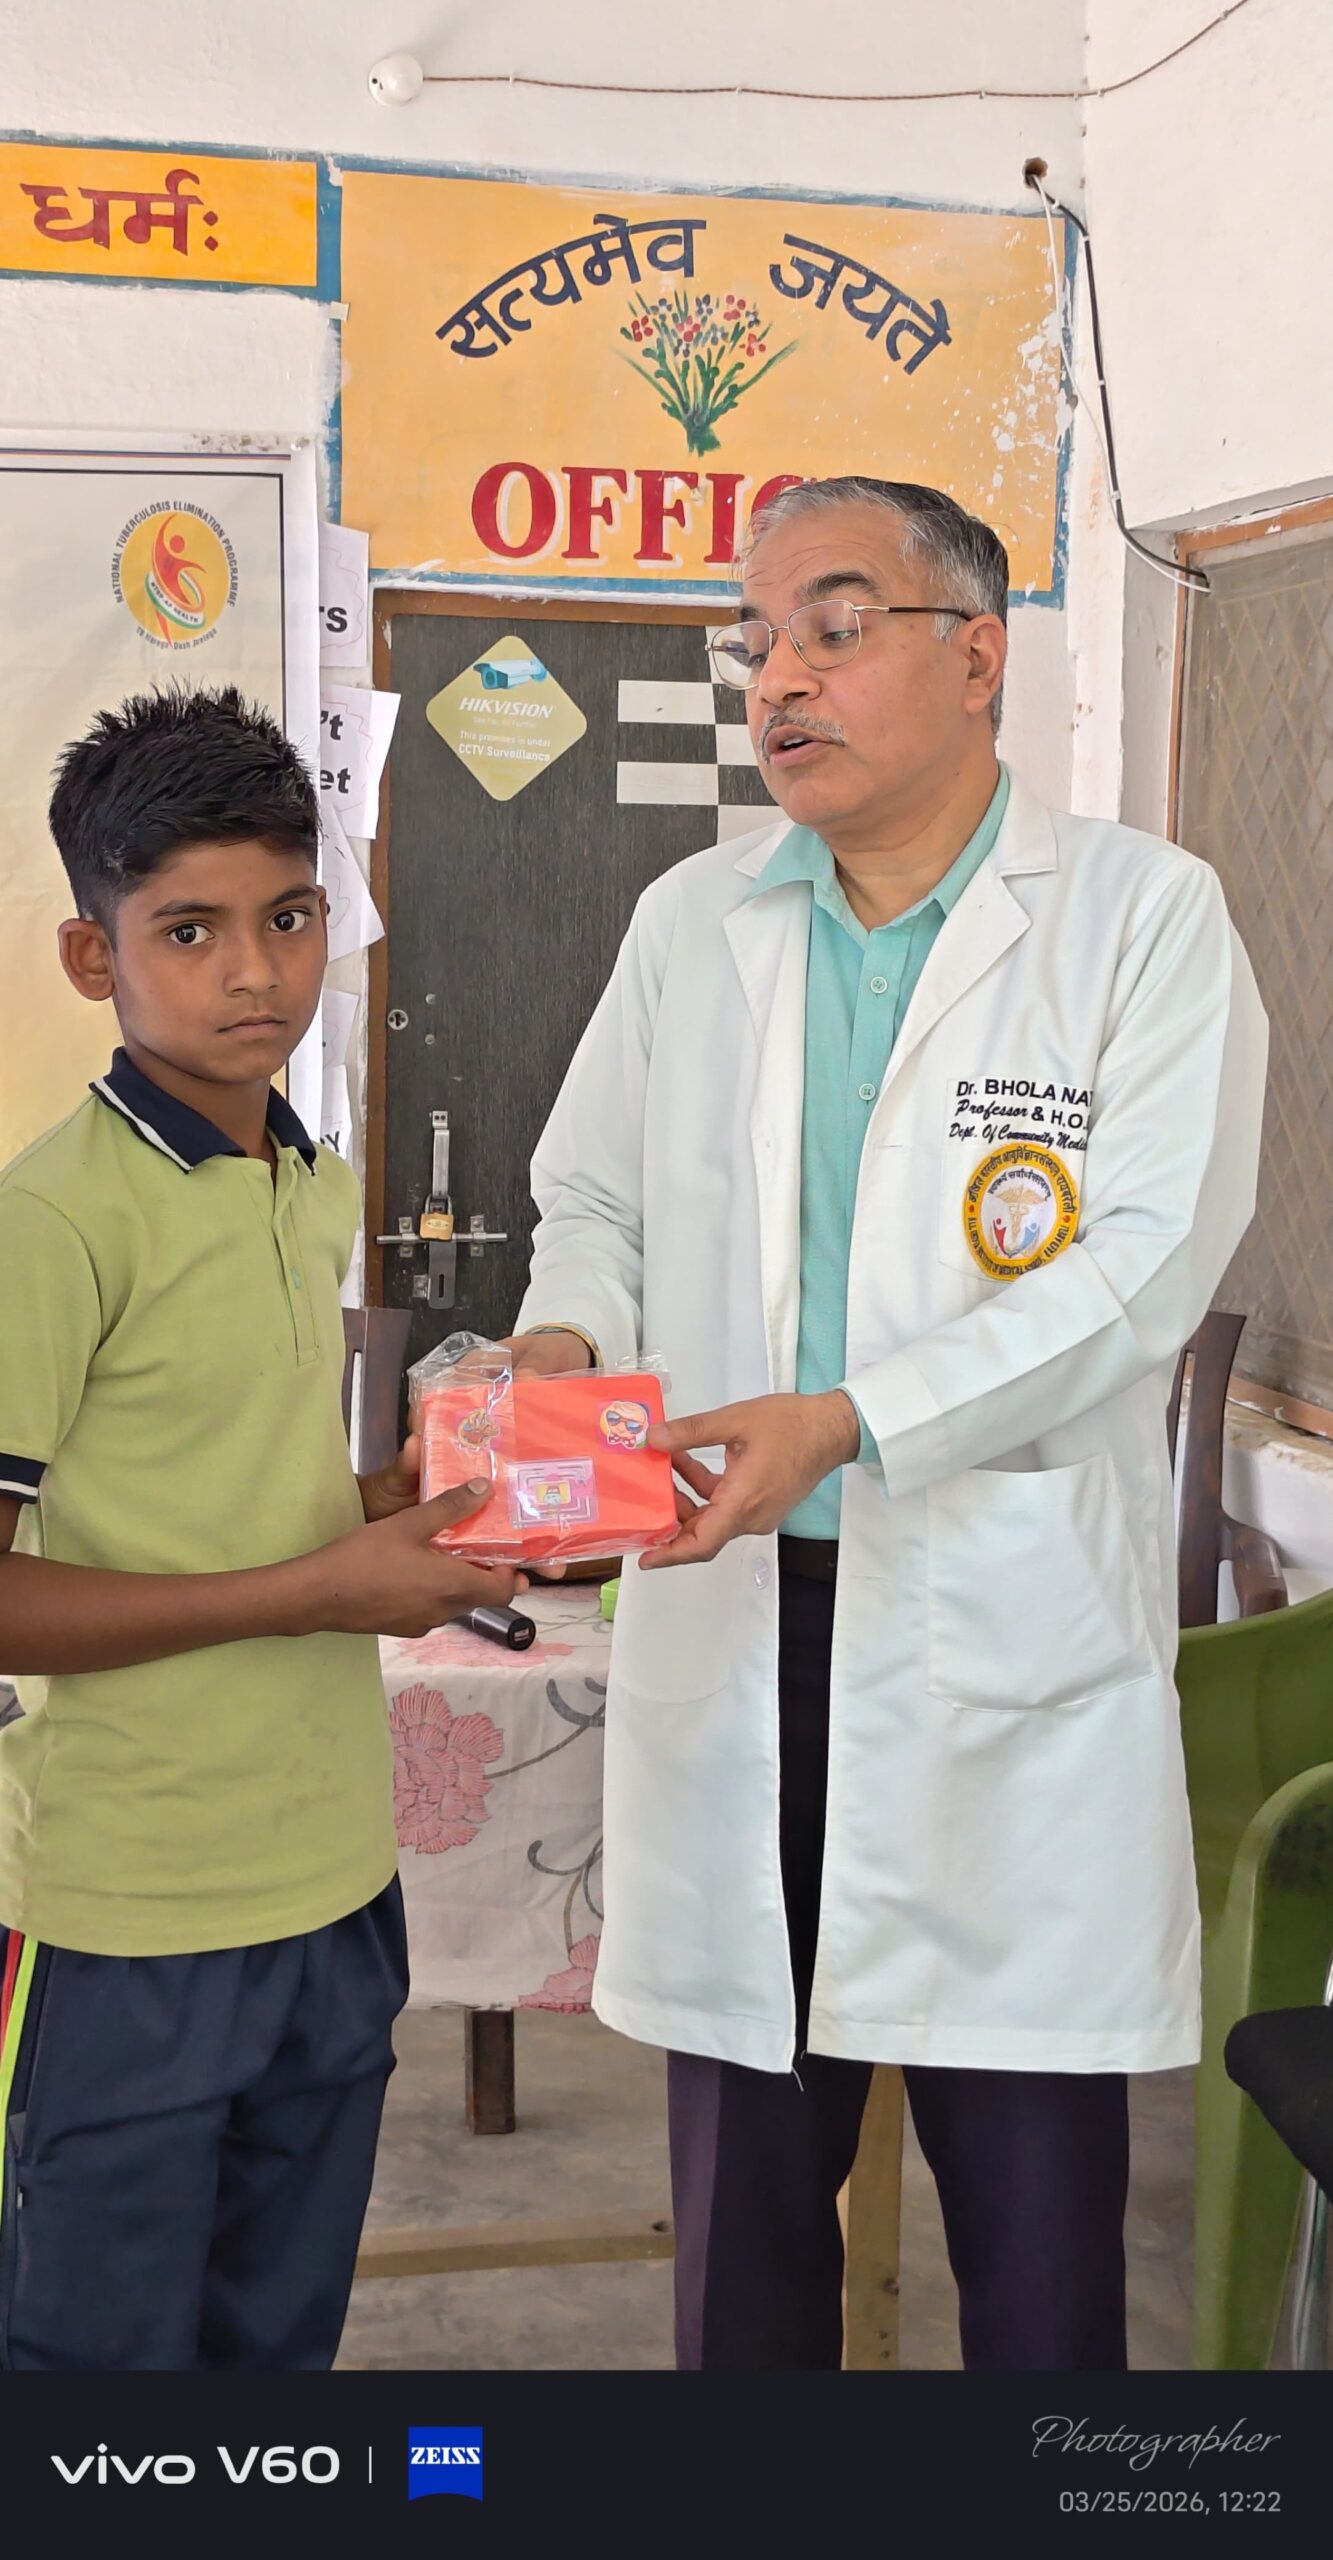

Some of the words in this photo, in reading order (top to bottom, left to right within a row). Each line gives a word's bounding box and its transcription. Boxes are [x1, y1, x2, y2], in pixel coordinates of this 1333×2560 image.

[435, 213, 707, 358] सत्यमेव
[768, 233, 953, 375] जयते
[116, 500, 171, 549] TUBERCULOSIS
[173, 500, 226, 539] ELIMINATION
[111, 552, 125, 604] NATIONAL
[222, 538, 239, 608] PROGRAMME
[458, 697, 554, 719] HIKVISION
[459, 743, 485, 756] CCTV
[487, 745, 551, 762] Surveillance
[956, 1081, 977, 1097] Dr.
[984, 1078, 1056, 1101] BHOLA
[955, 1099, 1028, 1121] Professor
[1031, 1106, 1045, 1122] &
[949, 1122, 978, 1142] Dept.
[982, 1123, 998, 1144] Of
